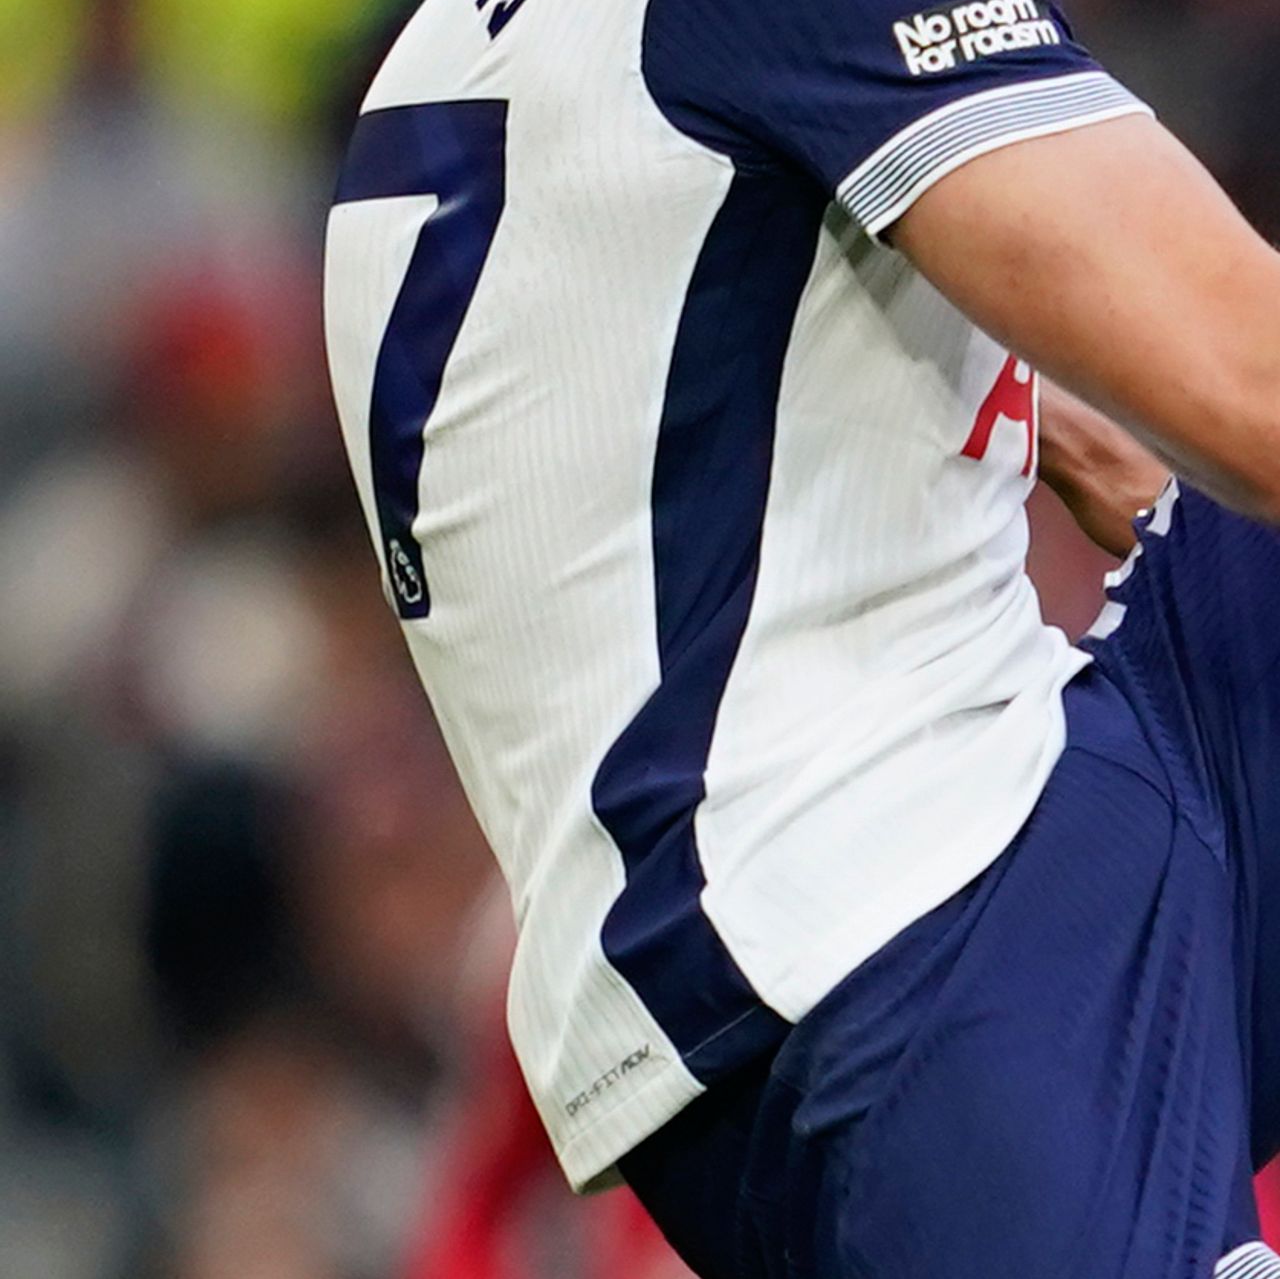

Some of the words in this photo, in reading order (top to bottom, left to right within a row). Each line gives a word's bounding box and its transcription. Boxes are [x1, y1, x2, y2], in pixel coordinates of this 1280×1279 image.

[893, 14, 951, 54] No
[905, 39, 957, 76] for
[959, 19, 1060, 61] racism
